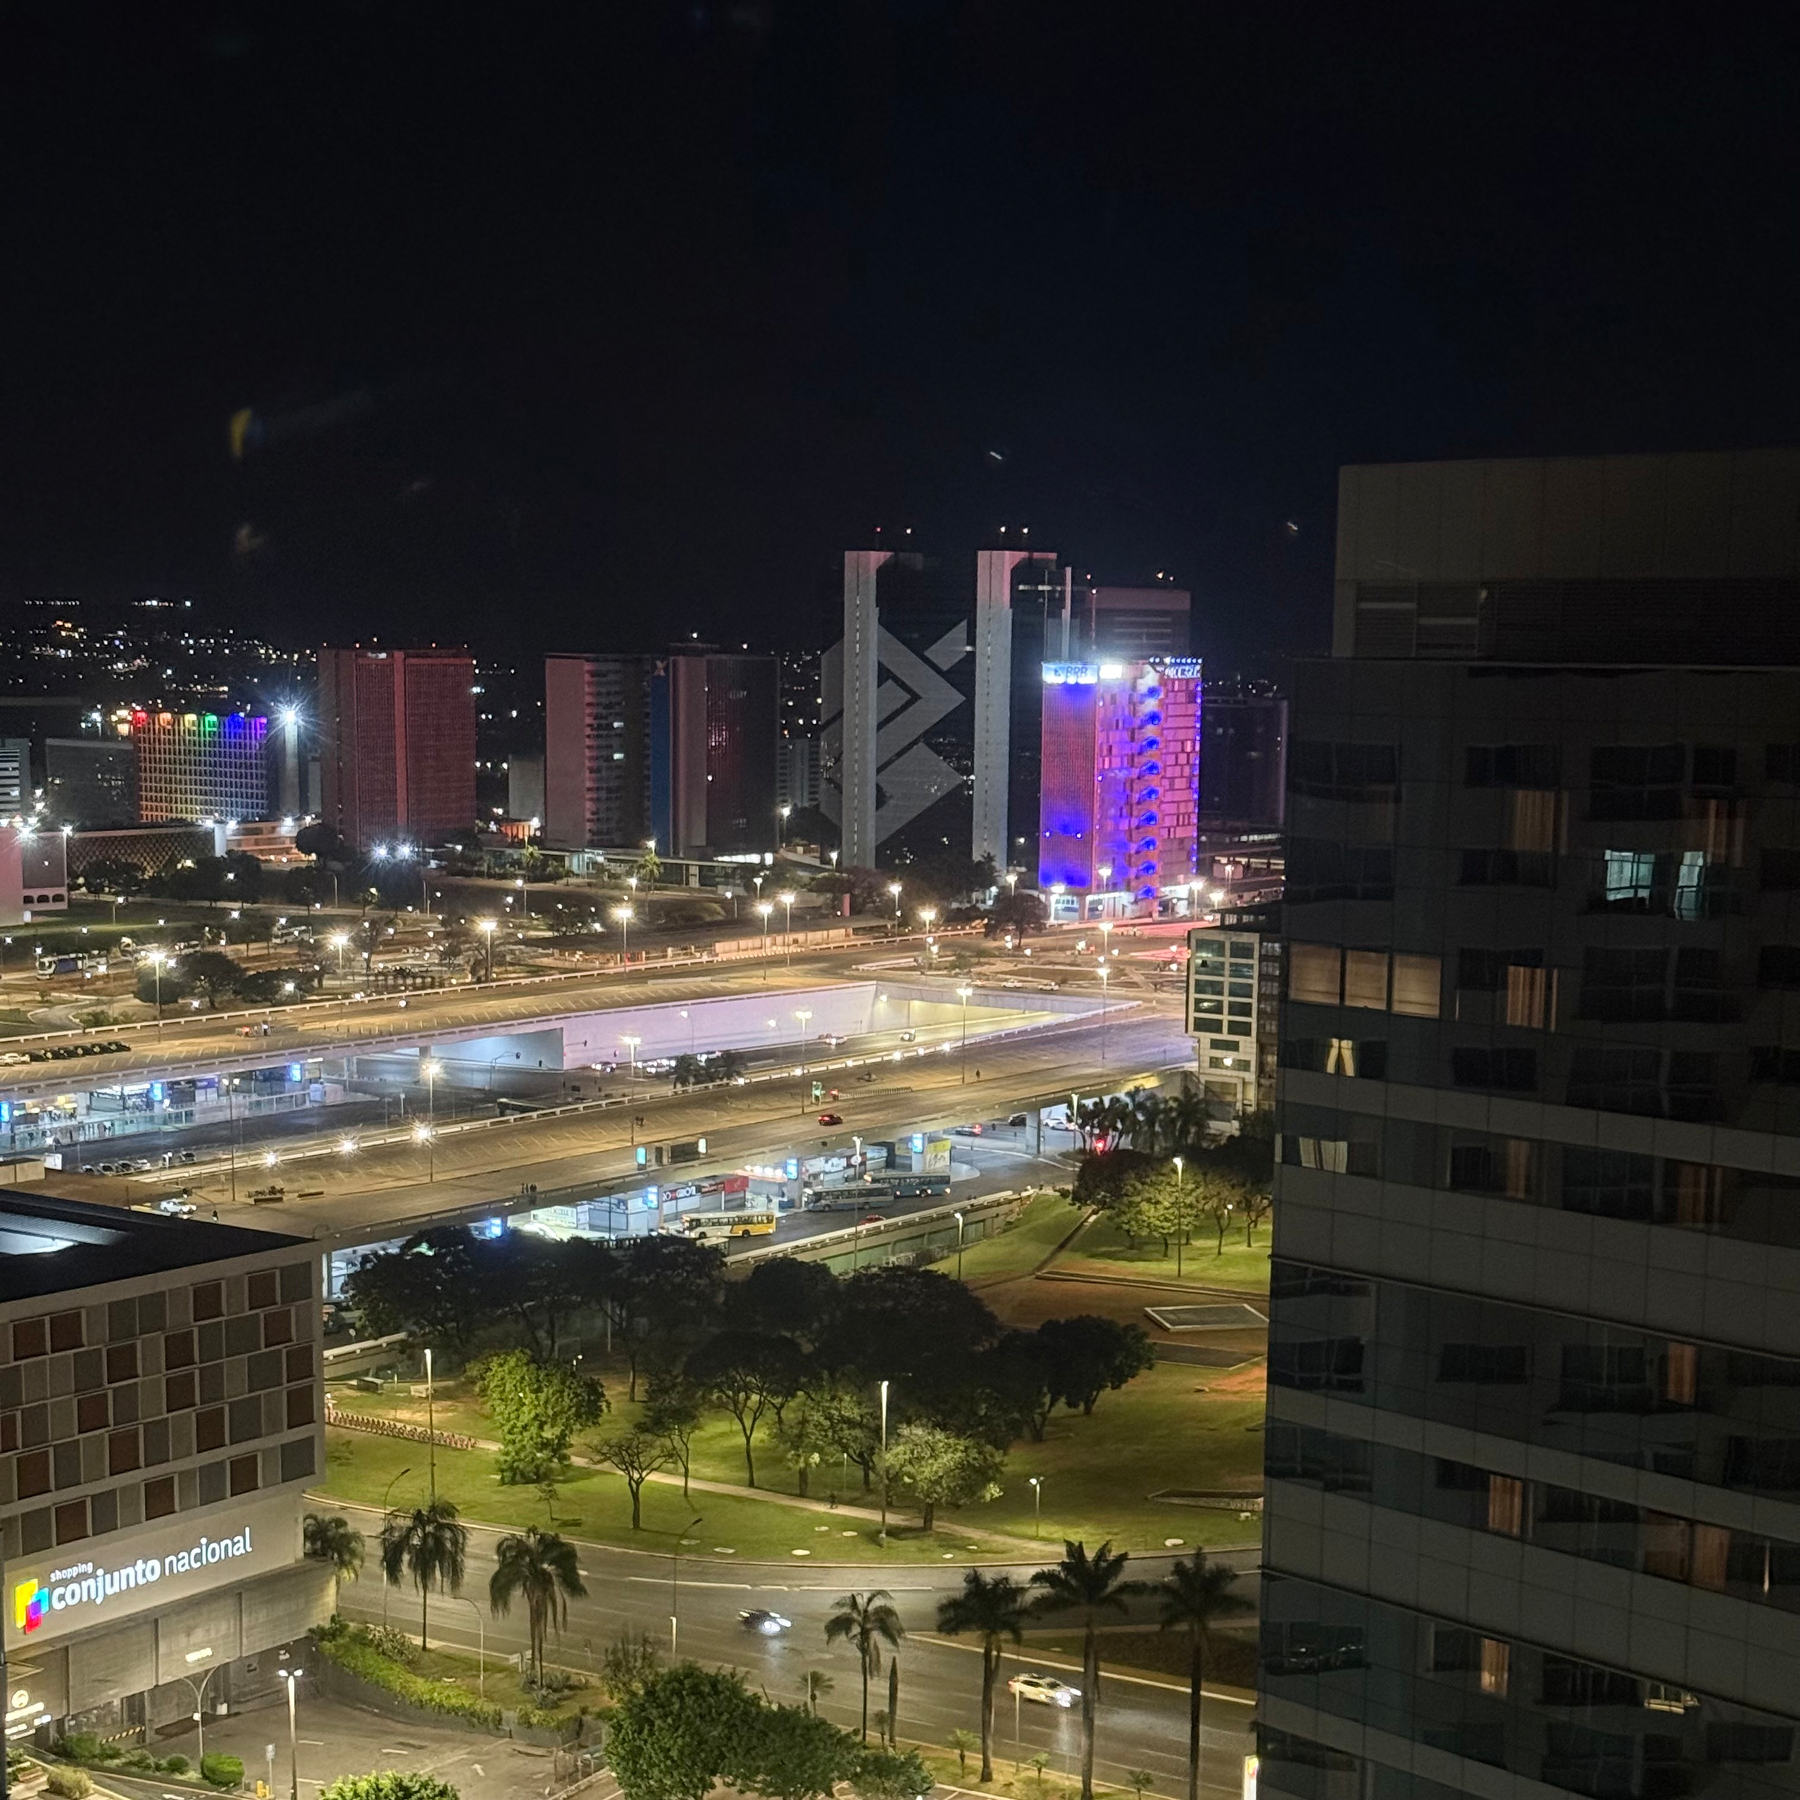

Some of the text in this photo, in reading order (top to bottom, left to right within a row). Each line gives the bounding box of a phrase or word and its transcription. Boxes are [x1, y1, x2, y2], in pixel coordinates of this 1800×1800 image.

[50, 1562, 93, 1582] shopping
[51, 1526, 253, 1610] conjunto nacional
